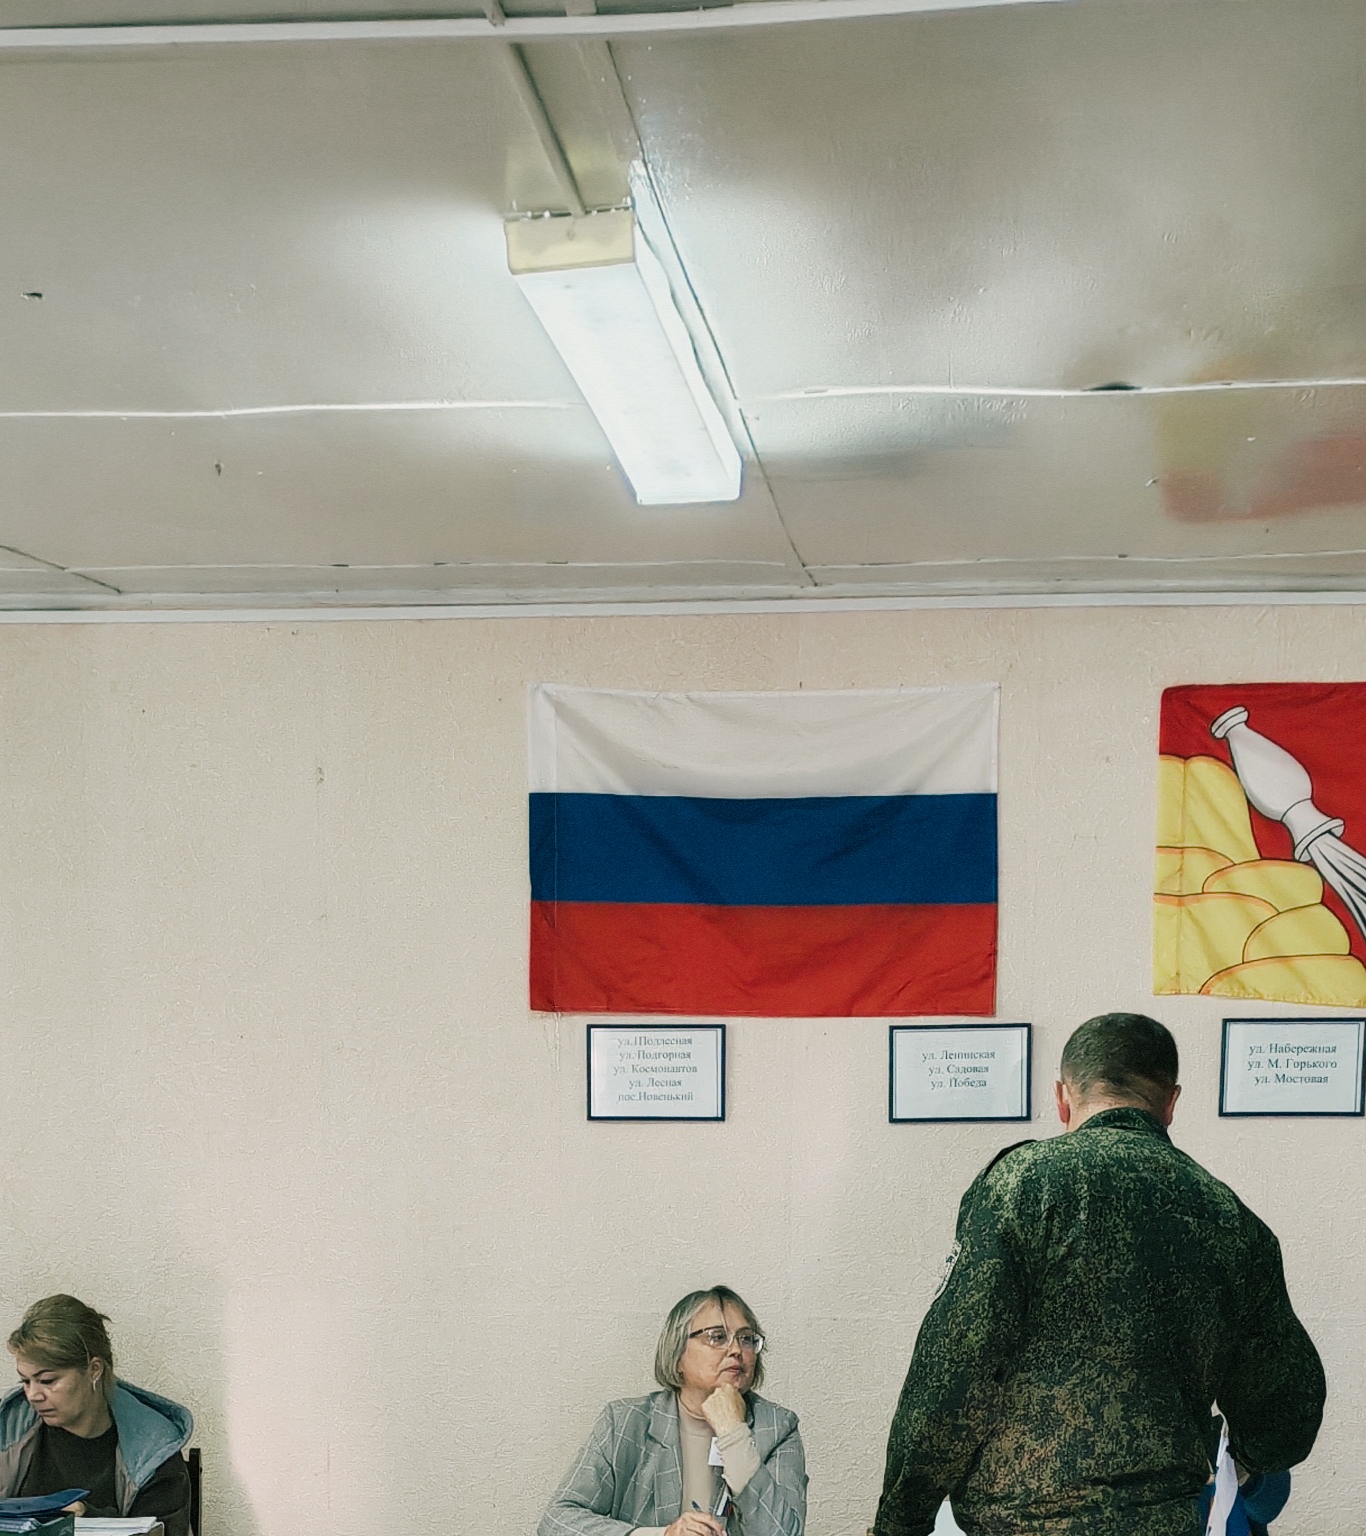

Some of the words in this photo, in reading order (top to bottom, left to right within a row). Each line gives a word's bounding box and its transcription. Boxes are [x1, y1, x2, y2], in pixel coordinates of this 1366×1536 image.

[1249, 1045, 1265, 1055] ул.
[1269, 1043, 1337, 1055] Набережная
[637, 1050, 692, 1061] Подгорная
[922, 1051, 938, 1062] ул.
[940, 1050, 996, 1060] Ленинская
[631, 1064, 698, 1074] Космонавтов
[928, 1066, 944, 1076] ул.
[946, 1064, 989, 1074] Садовая
[1247, 1060, 1263, 1071] ул.
[1268, 1059, 1282, 1069] М.
[1285, 1058, 1338, 1071] Горького
[628, 1079, 643, 1089] ул.
[646, 1078, 683, 1088] Лесная
[931, 1079, 946, 1090] ул.
[949, 1077, 988, 1088] Победа
[1254, 1076, 1270, 1086] ул.
[1274, 1073, 1329, 1084] Мостовая
